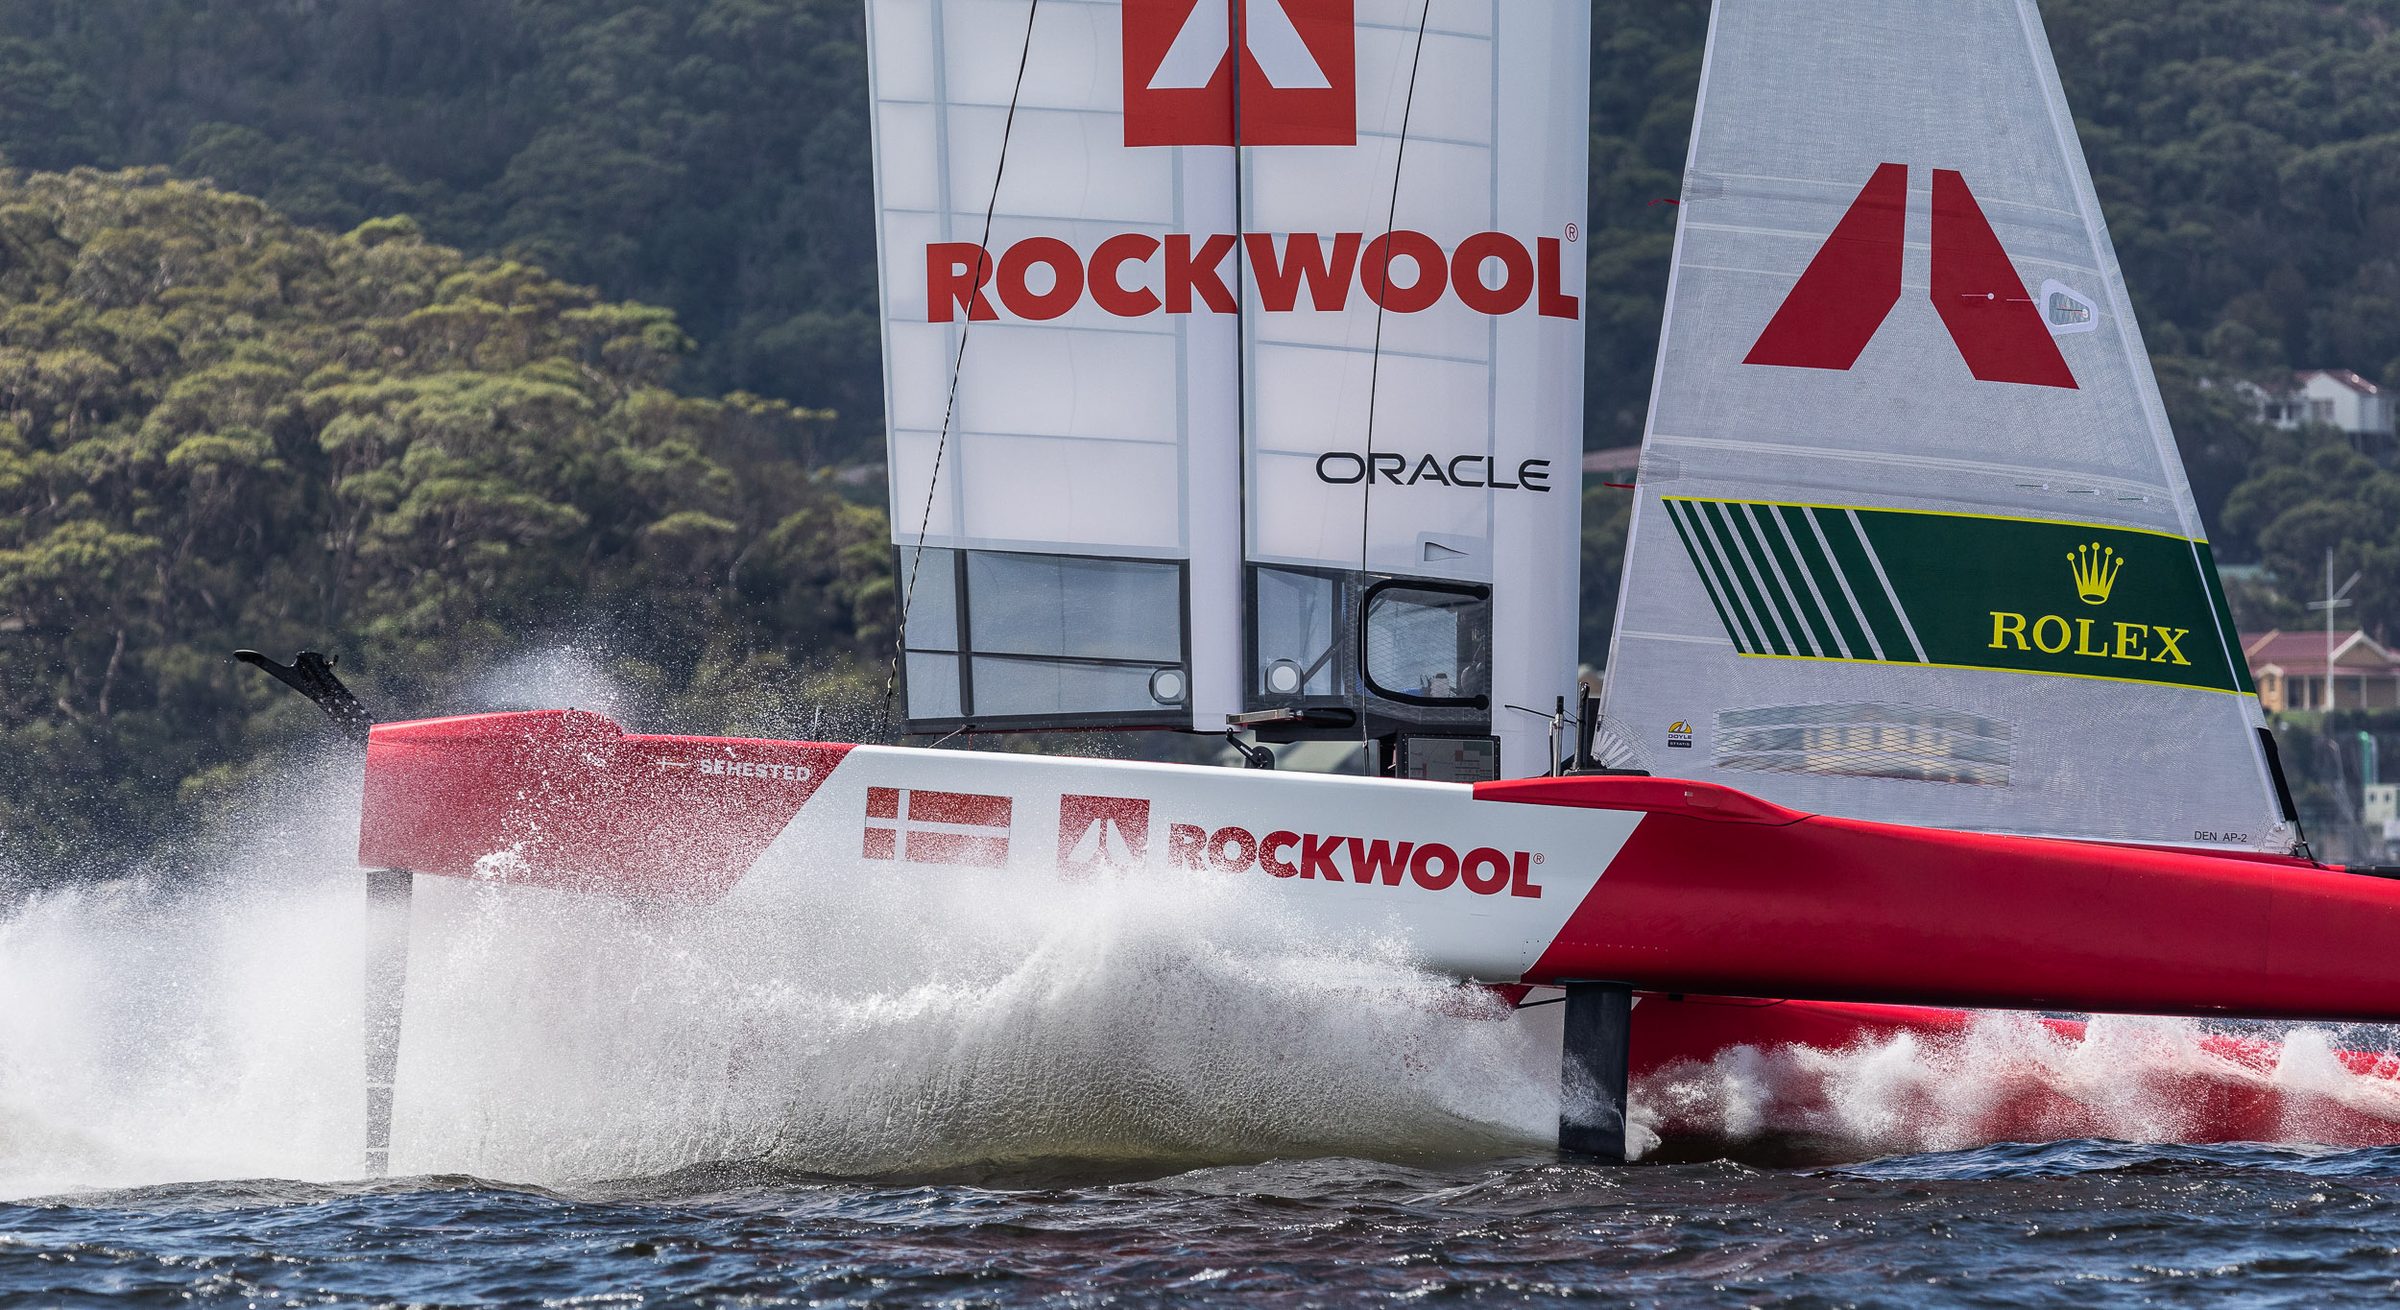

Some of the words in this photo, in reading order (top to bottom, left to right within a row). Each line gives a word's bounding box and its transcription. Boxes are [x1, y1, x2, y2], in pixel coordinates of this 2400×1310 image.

[1316, 454, 1551, 492] ORACLE
[1988, 611, 2191, 666] ROLEX
[699, 759, 810, 782] SEHESTED
[2194, 831, 2217, 841] DEN
[2222, 833, 2248, 843] AP-2
